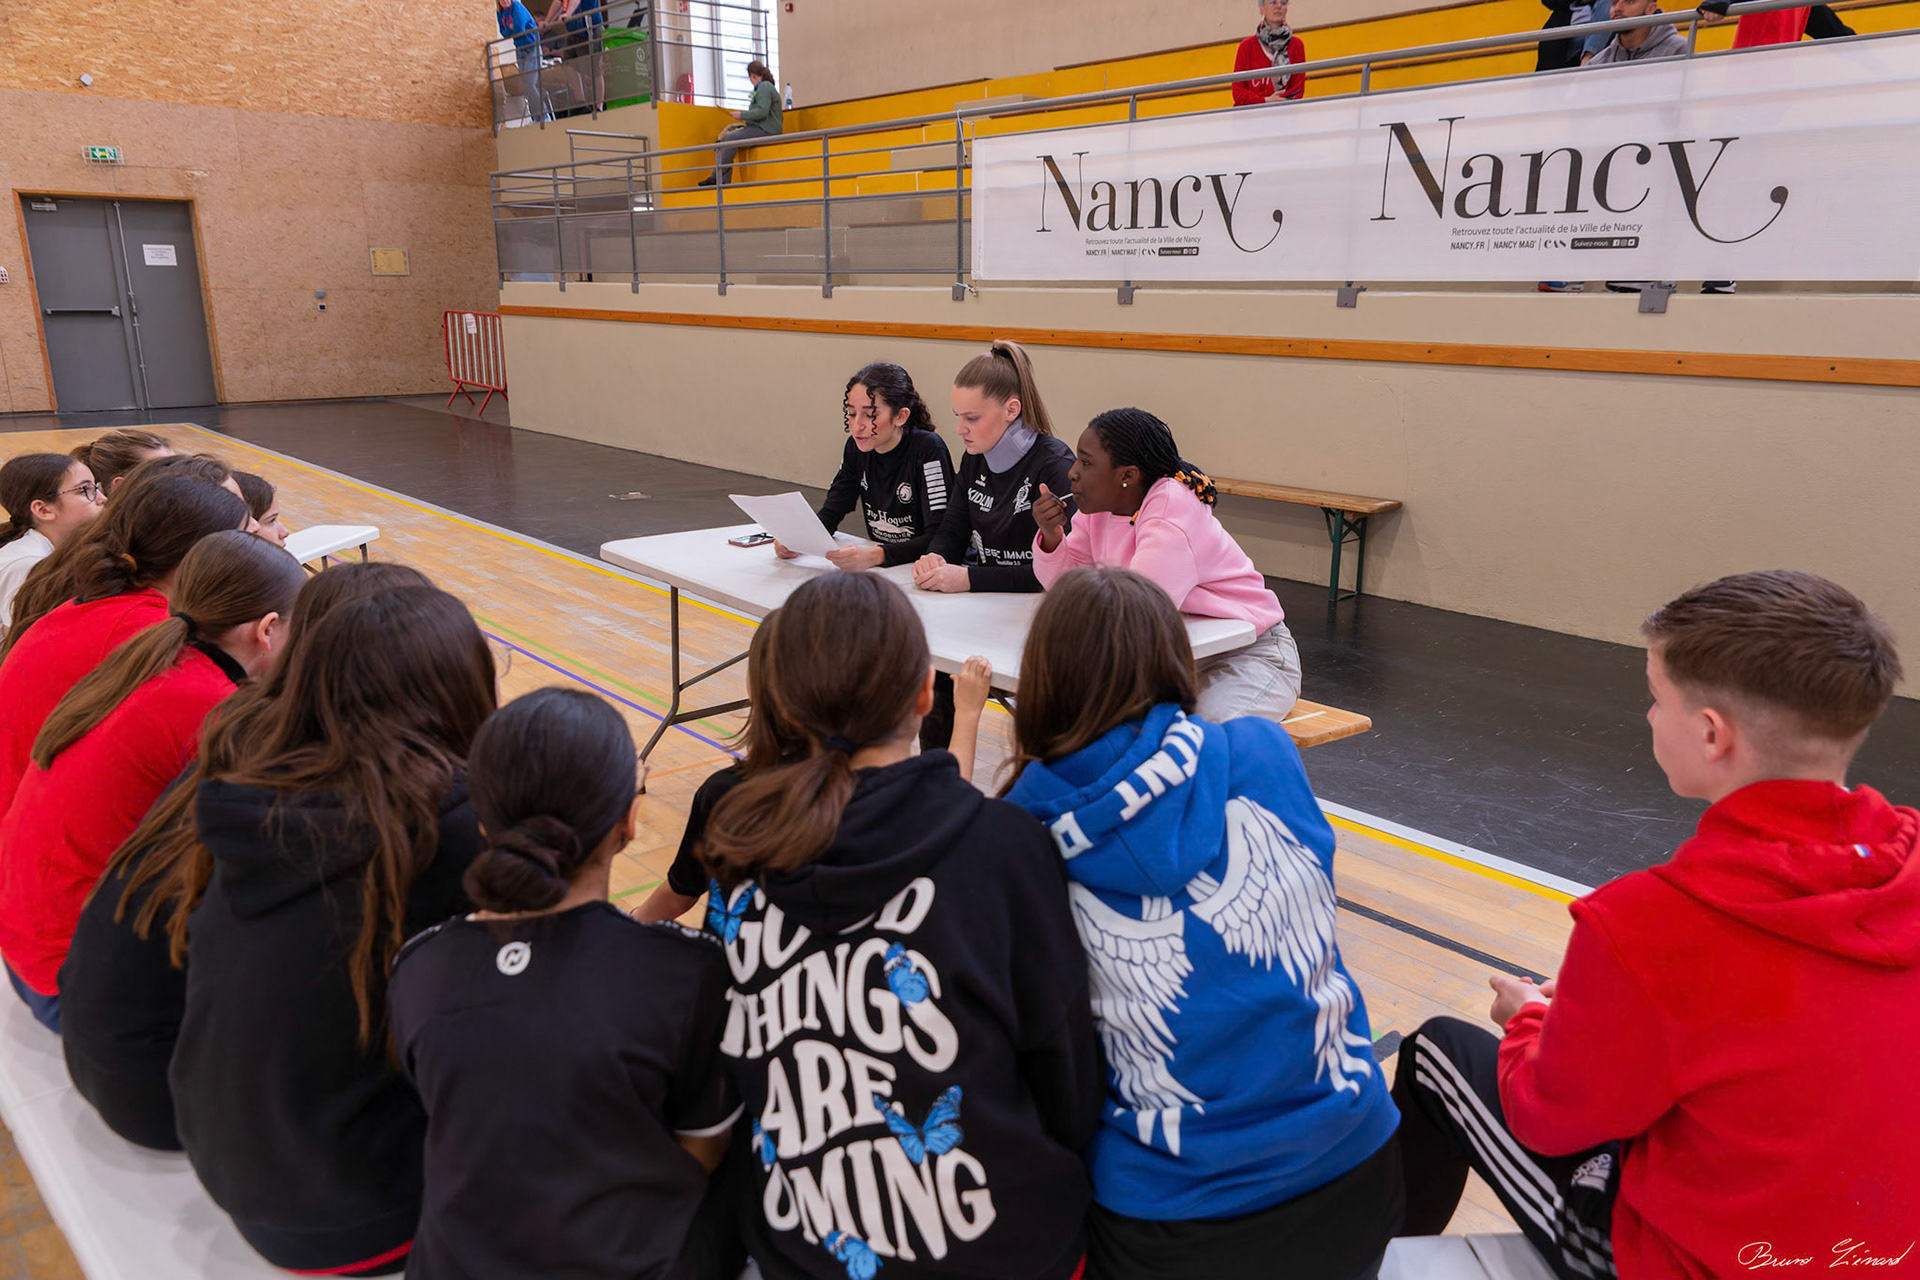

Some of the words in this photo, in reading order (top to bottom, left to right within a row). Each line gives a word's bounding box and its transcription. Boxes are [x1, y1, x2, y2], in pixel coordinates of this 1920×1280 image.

[1036, 151, 1283, 253] Nancy
[1369, 116, 1789, 243] Nancy
[1111, 248, 1126, 256] NANCY
[1163, 236, 1175, 244] Ville
[1183, 236, 1201, 244] Nancy
[1450, 241, 1484, 250] NANCY.FR
[1493, 241, 1517, 249] NANCY
[1451, 227, 1491, 236] Retrouvez
[1492, 227, 1514, 235] toute
[1515, 225, 1555, 235] l'actualité
[1557, 224, 1568, 233] de
[1570, 224, 1578, 233] la
[1580, 223, 1598, 232] Ville
[1599, 223, 1611, 232] de
[1613, 223, 1642, 233] Nancy
[878, 510, 913, 527] Hoquet
[720, 937, 959, 1073] THINGS
[761, 1039, 905, 1160] ARE
[753, 1135, 997, 1261] OMING
